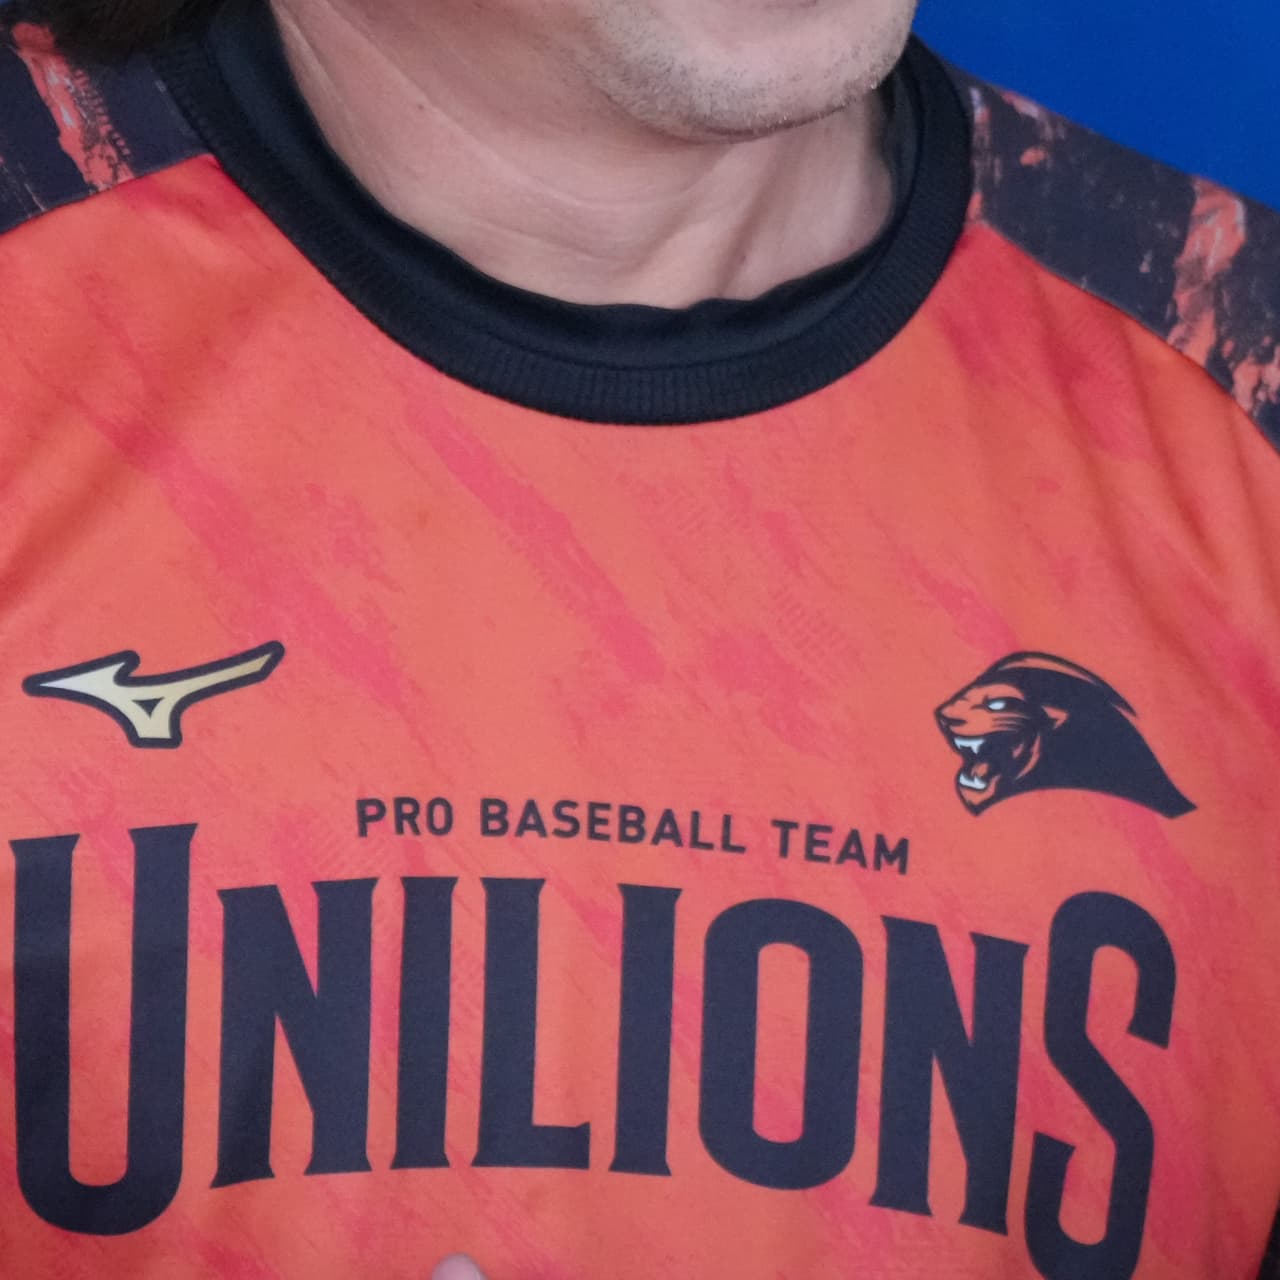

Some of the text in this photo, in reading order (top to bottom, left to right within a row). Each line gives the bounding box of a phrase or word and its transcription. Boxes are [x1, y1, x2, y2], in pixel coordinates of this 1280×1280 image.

[356, 796, 909, 875] PRO BASEBALL TEAM
[10, 822, 1176, 1280] UNILIONS
